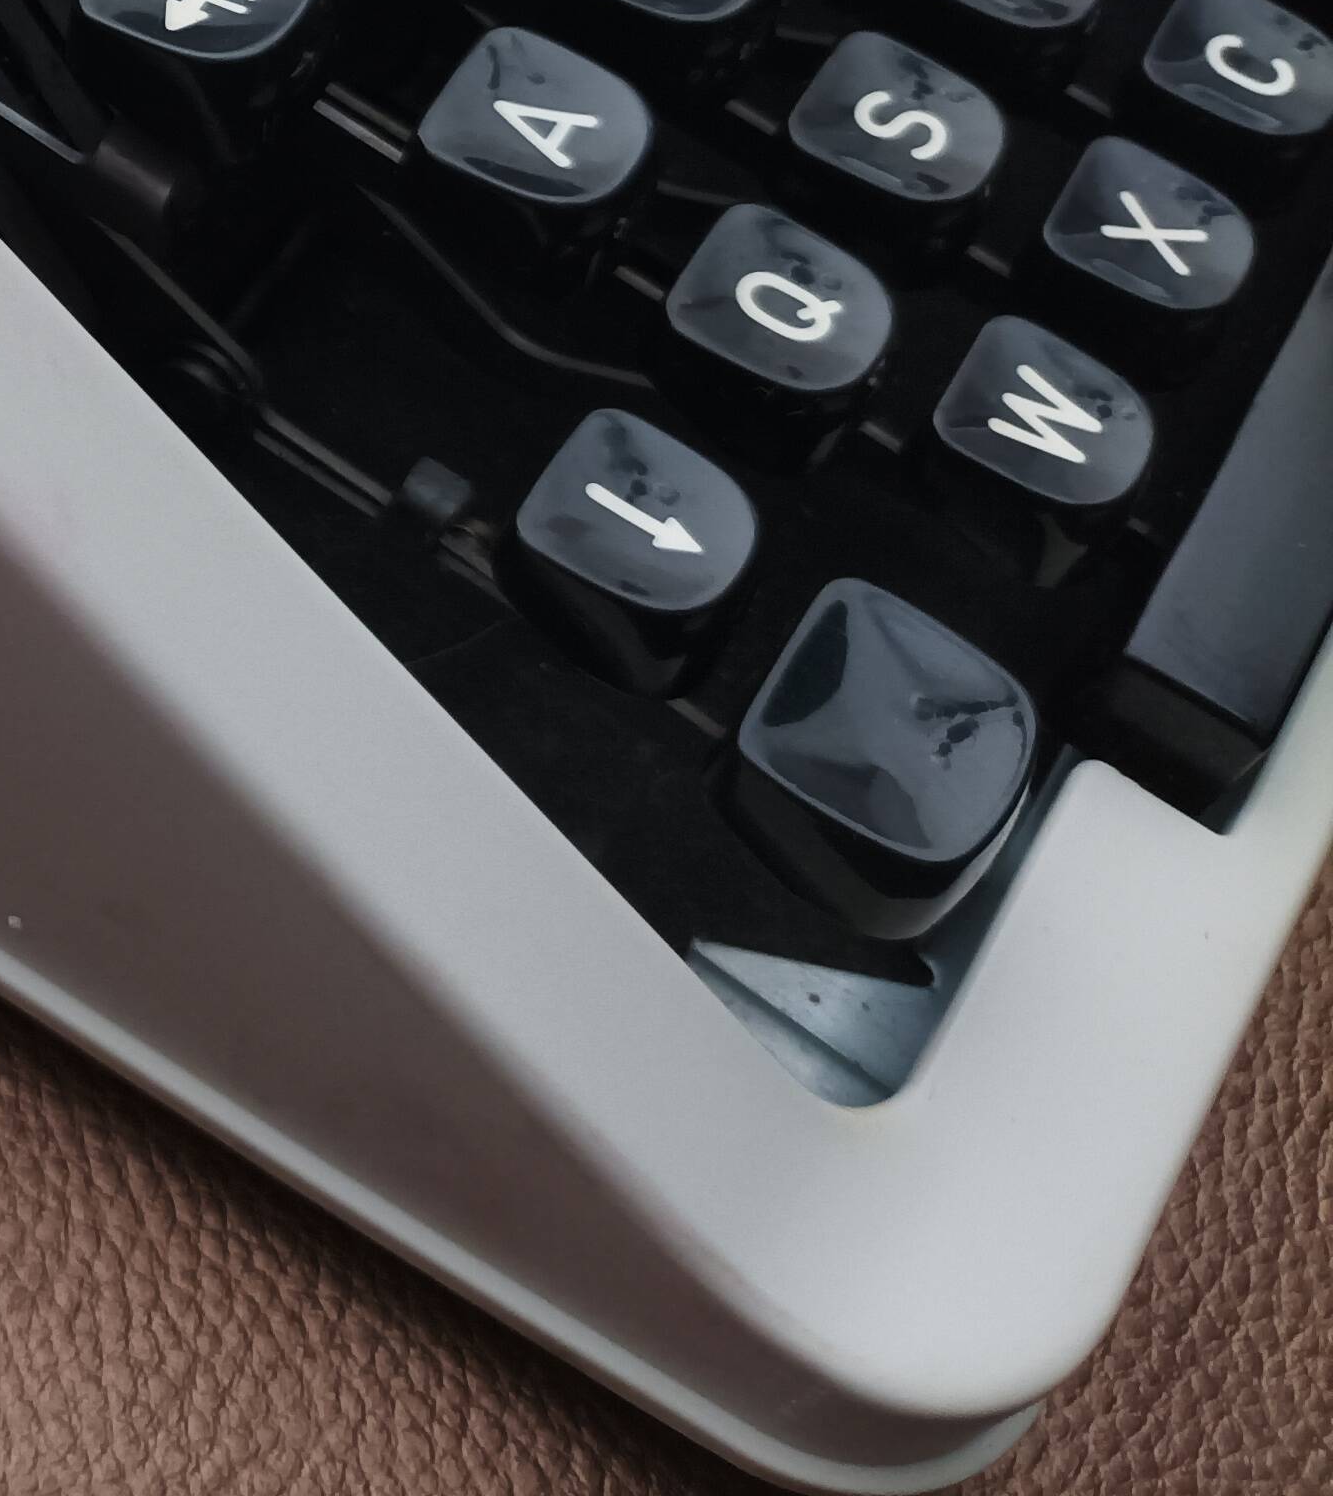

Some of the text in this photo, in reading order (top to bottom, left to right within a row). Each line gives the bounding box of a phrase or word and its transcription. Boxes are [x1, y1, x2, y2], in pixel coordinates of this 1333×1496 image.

[1205, 33, 1297, 97] C
[492, 99, 601, 169] A
[853, 89, 950, 161] S
[1099, 189, 1210, 277] X
[734, 270, 845, 343] Q
[986, 363, 1105, 465] W
